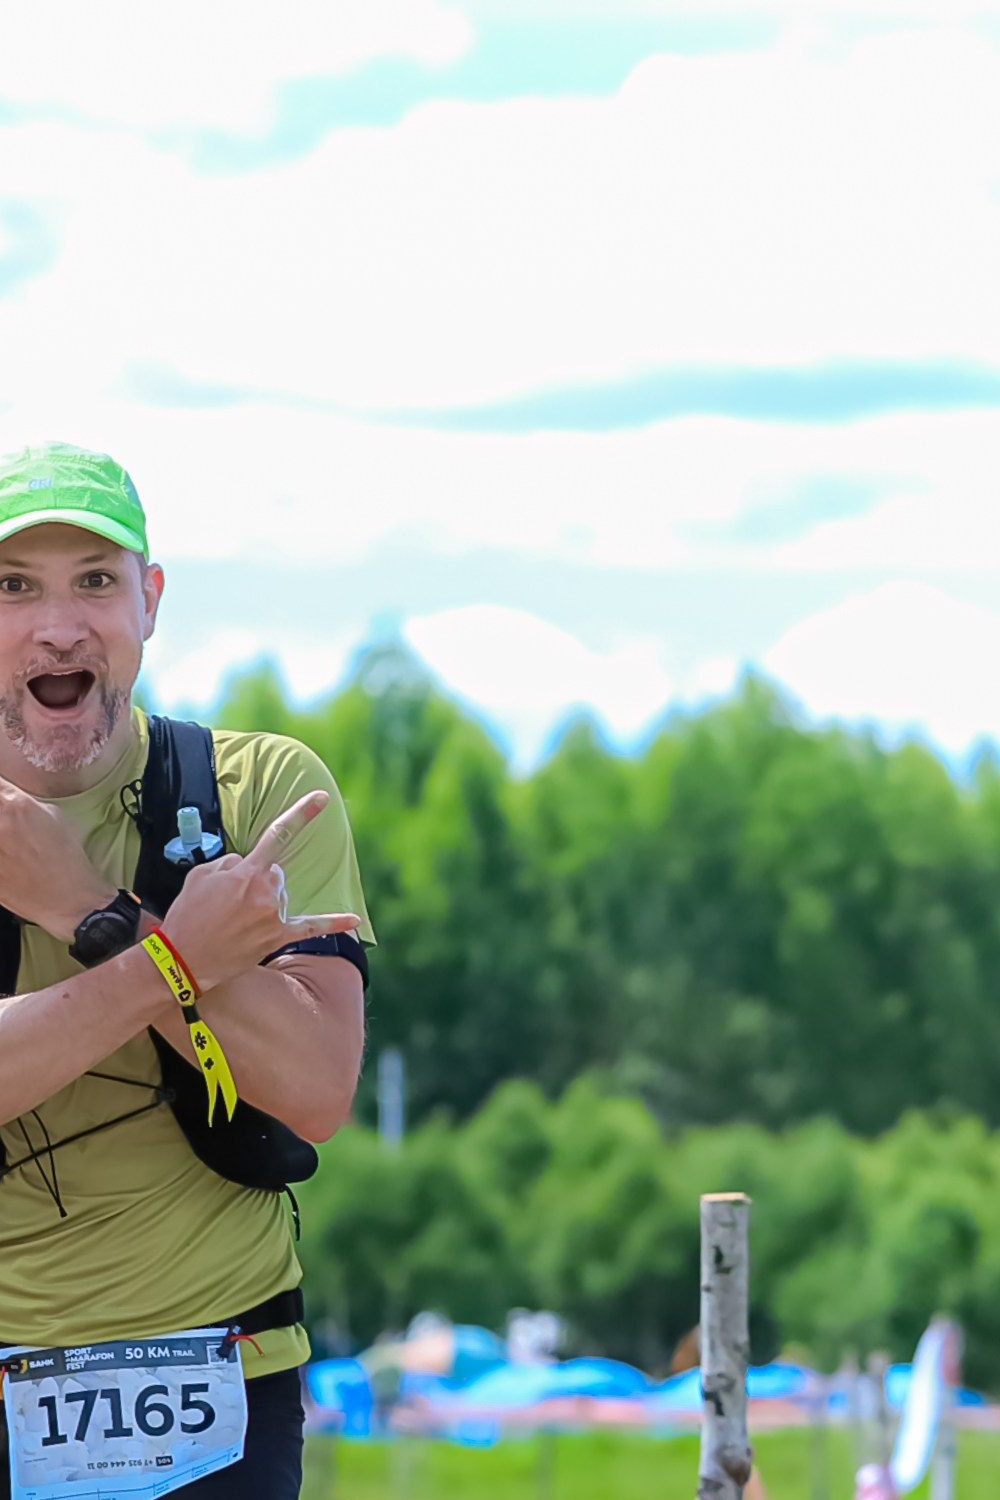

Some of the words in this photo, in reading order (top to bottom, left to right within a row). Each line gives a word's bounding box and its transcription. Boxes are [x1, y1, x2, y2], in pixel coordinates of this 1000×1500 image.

[64, 1347, 92, 1357] SPORT
[124, 1346, 144, 1360] 50
[147, 1345, 170, 1359] KM
[172, 1348, 196, 1358] TRAIL
[66, 1361, 86, 1371] FEST
[37, 1382, 216, 1447] 17165
